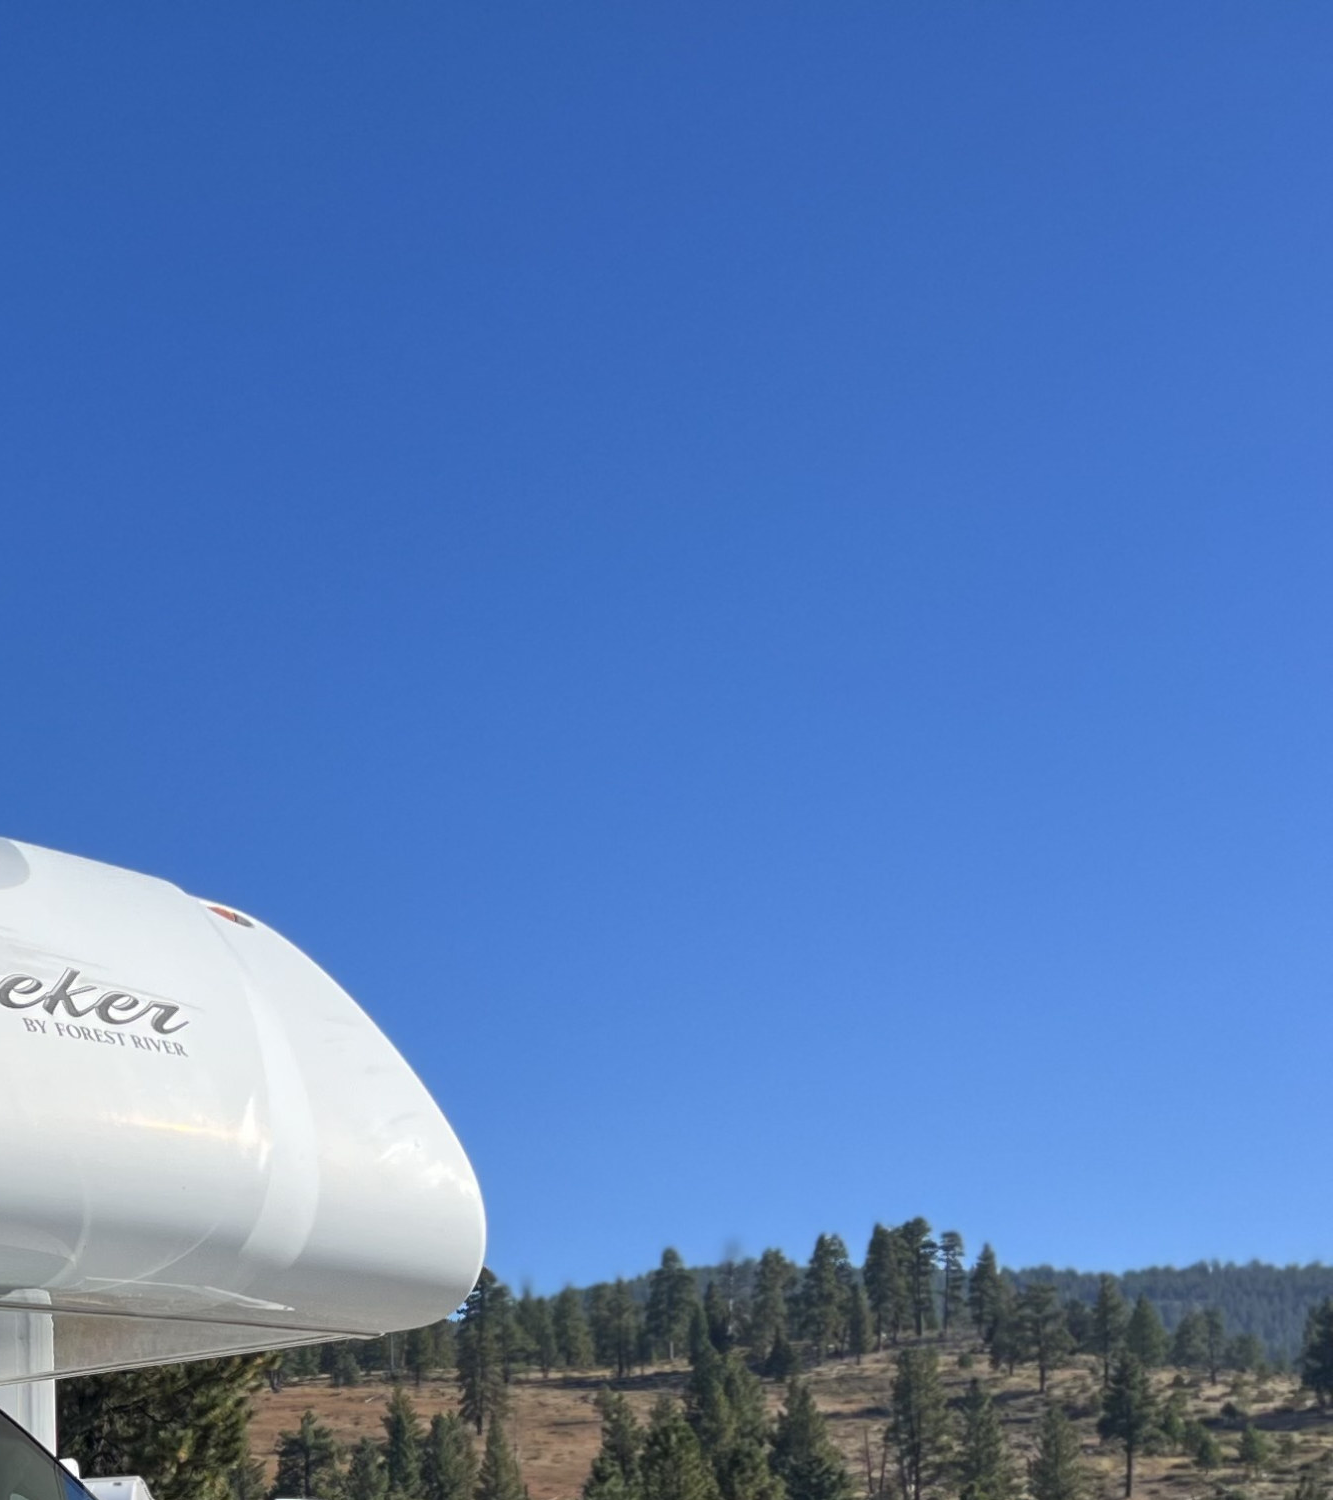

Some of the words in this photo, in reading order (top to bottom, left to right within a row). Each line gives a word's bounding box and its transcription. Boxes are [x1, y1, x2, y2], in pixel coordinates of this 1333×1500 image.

[22, 1017, 47, 1034] BY
[54, 1022, 125, 1046] FOREST
[130, 1034, 189, 1058] RIVER
